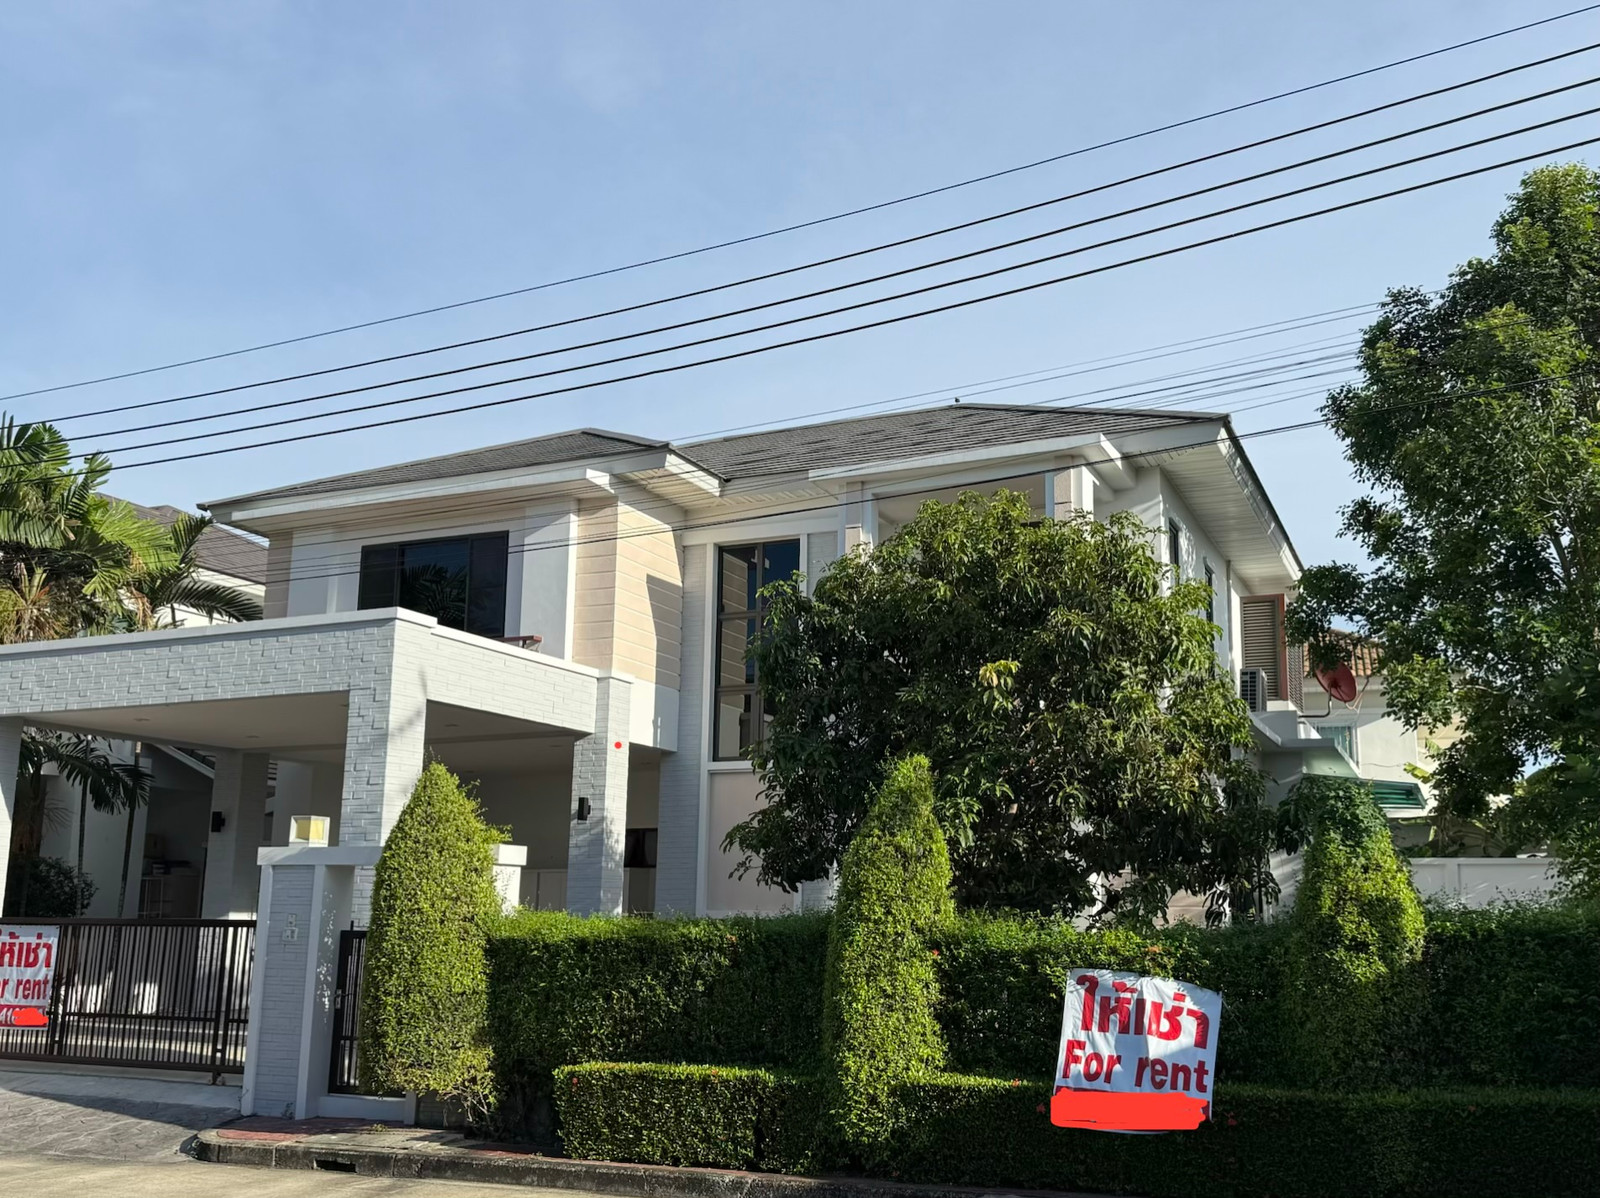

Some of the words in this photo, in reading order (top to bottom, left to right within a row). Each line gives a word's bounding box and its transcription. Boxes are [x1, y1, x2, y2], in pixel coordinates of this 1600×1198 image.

[0, 928, 53, 968] ห้เช่า
[14, 974, 49, 1000] rent
[1076, 974, 1210, 1049] ให้เช่า
[1062, 1039, 1122, 1084] For
[1134, 1056, 1209, 1094] rent
